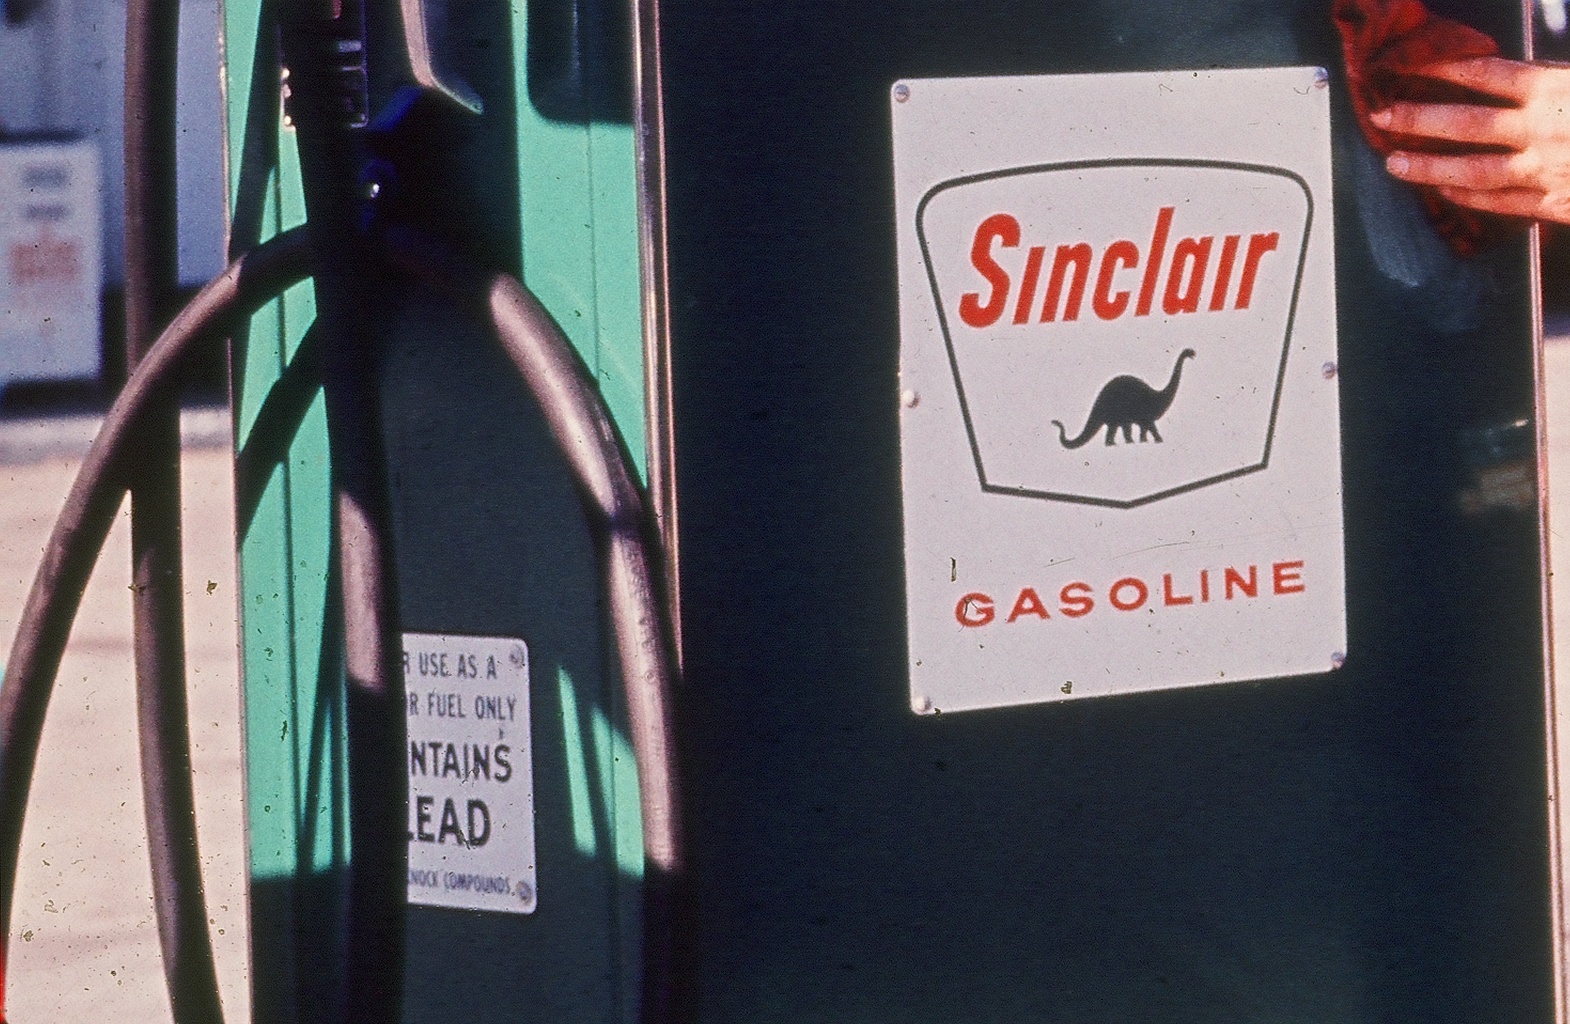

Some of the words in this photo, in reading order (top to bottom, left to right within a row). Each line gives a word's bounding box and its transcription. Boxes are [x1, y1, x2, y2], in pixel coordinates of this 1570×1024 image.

[957, 206, 1280, 329] Sinclair
[954, 559, 1306, 629] GASOLINE
[419, 651, 448, 677] USE
[457, 654, 477, 679] AS
[486, 655, 497, 680] A
[428, 694, 467, 720] FUEL
[475, 695, 517, 722] ONLY
[410, 741, 512, 783] NTAINS
